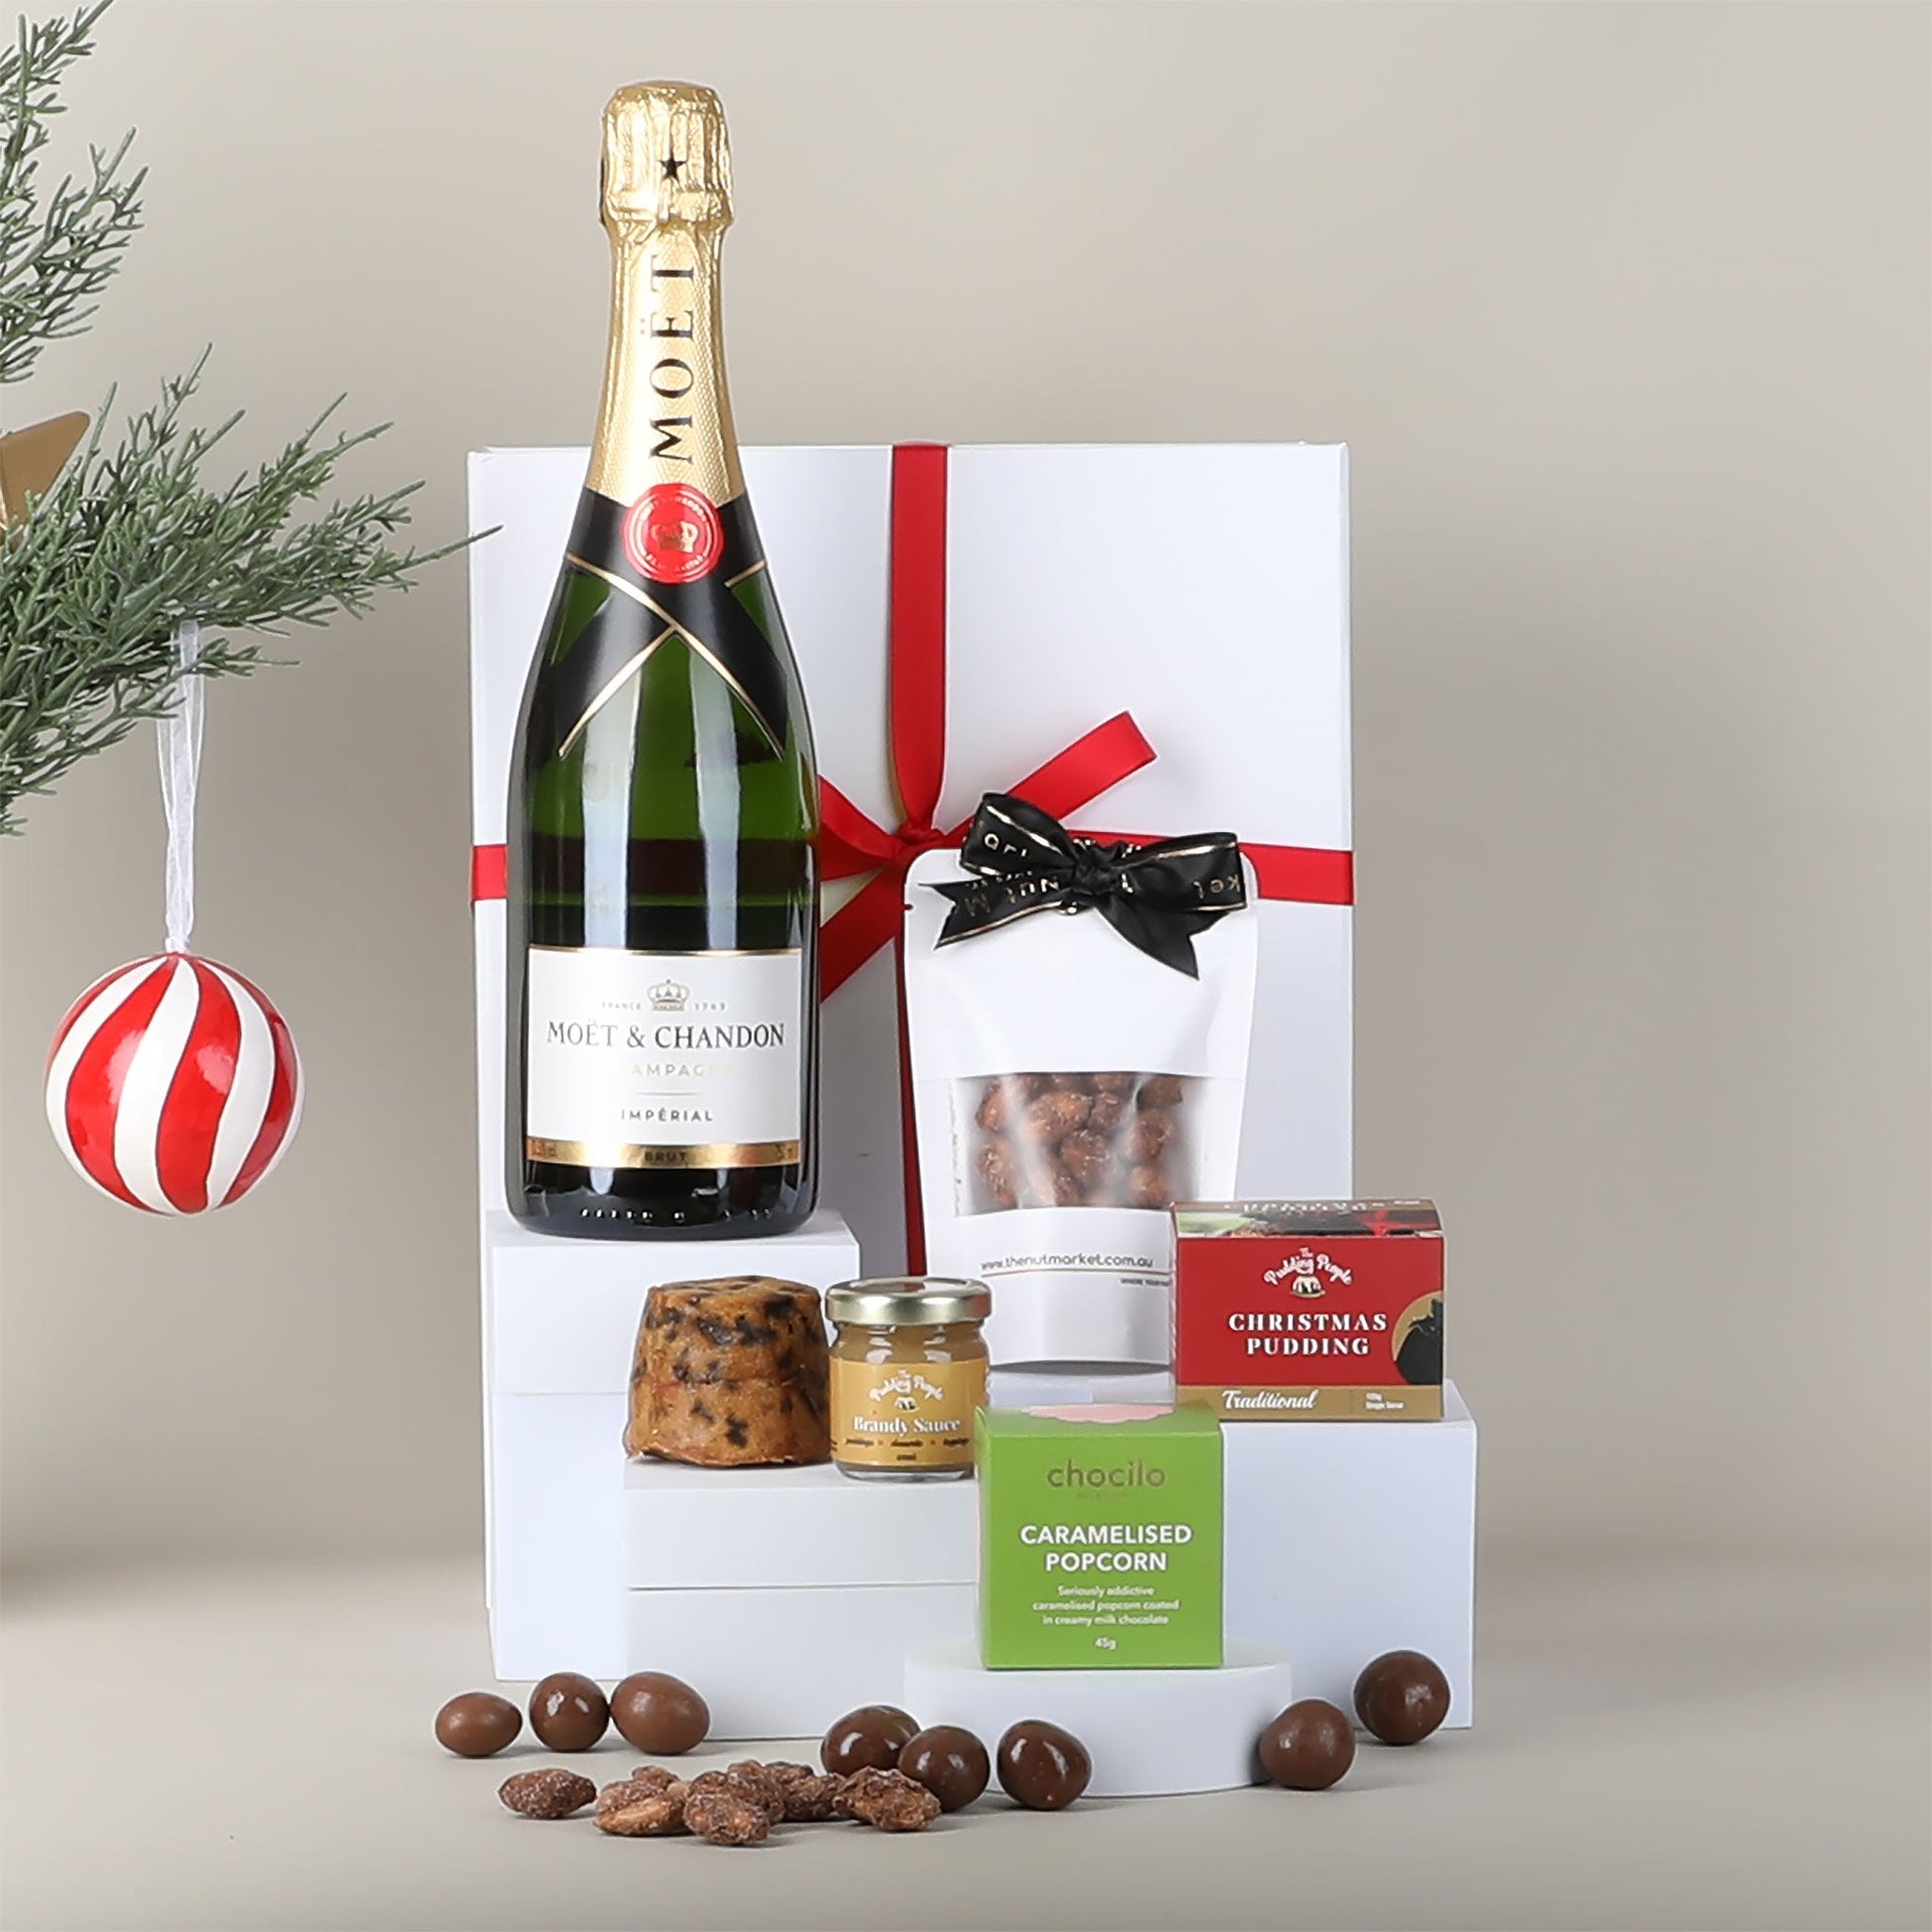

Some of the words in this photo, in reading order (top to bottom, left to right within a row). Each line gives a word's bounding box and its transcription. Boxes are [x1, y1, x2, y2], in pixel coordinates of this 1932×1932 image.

[638, 254, 695, 465] MOËT
[547, 1020, 619, 1047] MOËT
[626, 1025, 645, 1049] &
[654, 1022, 785, 1049] CHANDON
[621, 1107, 714, 1123] IMPÉRIAL
[643, 1150, 689, 1163] BRUT
[980, 1252, 1154, 1271] www.thenutmarket.com.au
[1263, 1255, 1314, 1286] Pudding
[1316, 1253, 1353, 1286] People
[1228, 1312, 1388, 1332] CHRISTMAS
[1246, 1337, 1370, 1355] PUDDING
[1221, 1389, 1320, 1410] Traditional
[853, 1416, 909, 1437] Brandy
[912, 1418, 961, 1434] Sauce
[1045, 1459, 1167, 1488] chocilo
[1020, 1525, 1193, 1545] CARAMELISED
[1045, 1553, 1168, 1572] POPCORN
[1057, 1585, 1105, 1598] Seriously
[1107, 1586, 1156, 1596] addictive
[1033, 1599, 1096, 1610] caramelised
[1097, 1601, 1142, 1613] popcorn
[1143, 1599, 1180, 1610] coated
[1042, 1614, 1053, 1625] in
[1054, 1616, 1093, 1626] creamy
[1094, 1614, 1117, 1625] milk
[1118, 1614, 1170, 1625] chocolate
[1094, 1637, 1117, 1650] 45g
